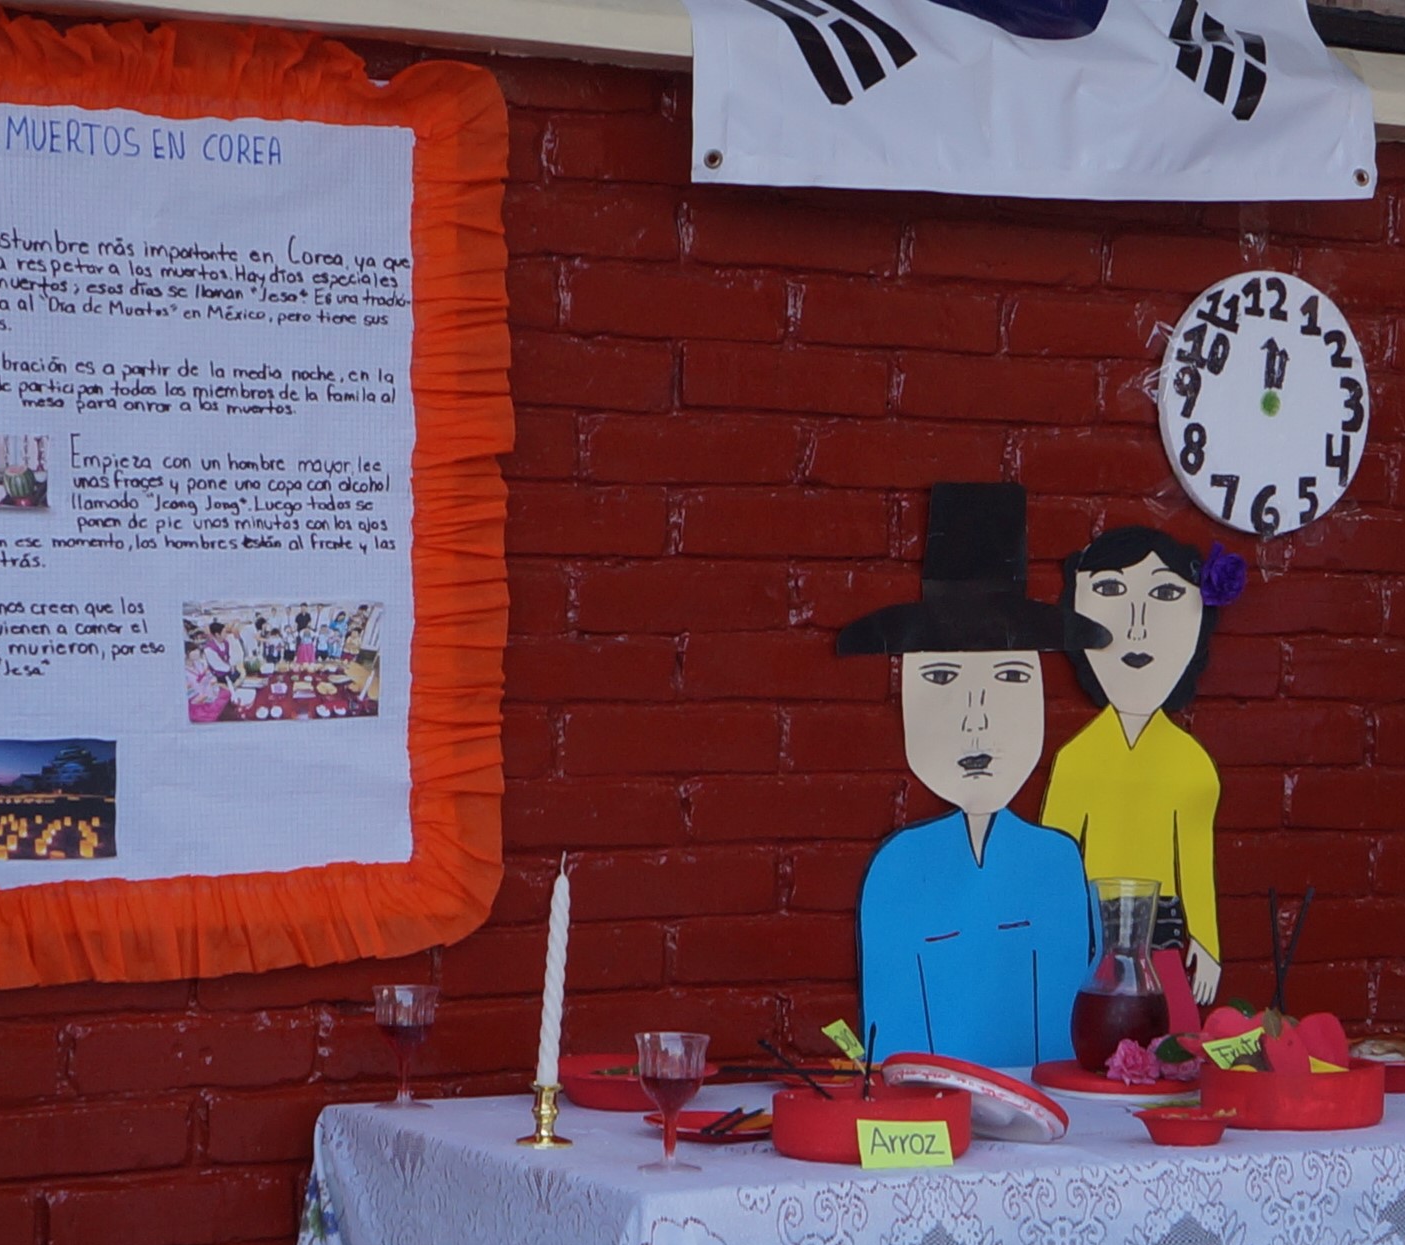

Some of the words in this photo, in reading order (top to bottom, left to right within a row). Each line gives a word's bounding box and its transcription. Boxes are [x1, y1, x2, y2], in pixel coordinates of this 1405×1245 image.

[7, 115, 141, 156] MUERTOS
[154, 128, 186, 161] EN
[202, 133, 283, 166] COREA
[17, 258, 104, 276] respetar
[108, 262, 121, 276] a
[129, 261, 151, 278] los
[235, 264, 266, 288] Hay
[312, 271, 398, 290] especiales
[249, 250, 274, 263] en
[354, 255, 376, 272] ya
[383, 255, 411, 270] que
[1196, 288, 1241, 333] 11
[1241, 277, 1288, 322] 12
[1300, 295, 1322, 336] 1
[74, 361, 95, 375] es
[102, 363, 115, 376] a
[121, 359, 171, 381] partir
[177, 358, 199, 377] de
[209, 360, 225, 378] la
[232, 362, 282, 381] media
[291, 365, 345, 383] noche,
[348, 369, 369, 382] en
[378, 368, 394, 384] la
[1176, 322, 1230, 376] 10
[1324, 329, 1353, 368] 2
[1173, 366, 1202, 419] 9
[1340, 376, 1365, 432] 3
[70, 433, 153, 473] Empieza
[162, 454, 192, 469] con
[200, 455, 221, 471] un
[227, 452, 286, 473] hombre
[357, 455, 383, 472] lee
[1179, 422, 1207, 476] 8
[1325, 433, 1351, 487] 4
[1210, 474, 1240, 520] 7
[1250, 484, 1281, 536] 6
[1299, 476, 1319, 524] 5
[30, 602, 79, 616] creen
[84, 602, 114, 618] que
[121, 597, 145, 615] los
[57, 625, 68, 635] a
[75, 622, 123, 635] comer
[131, 620, 148, 634] el
[8, 641, 106, 660] murieron,
[871, 1127, 945, 1155] Arroz
